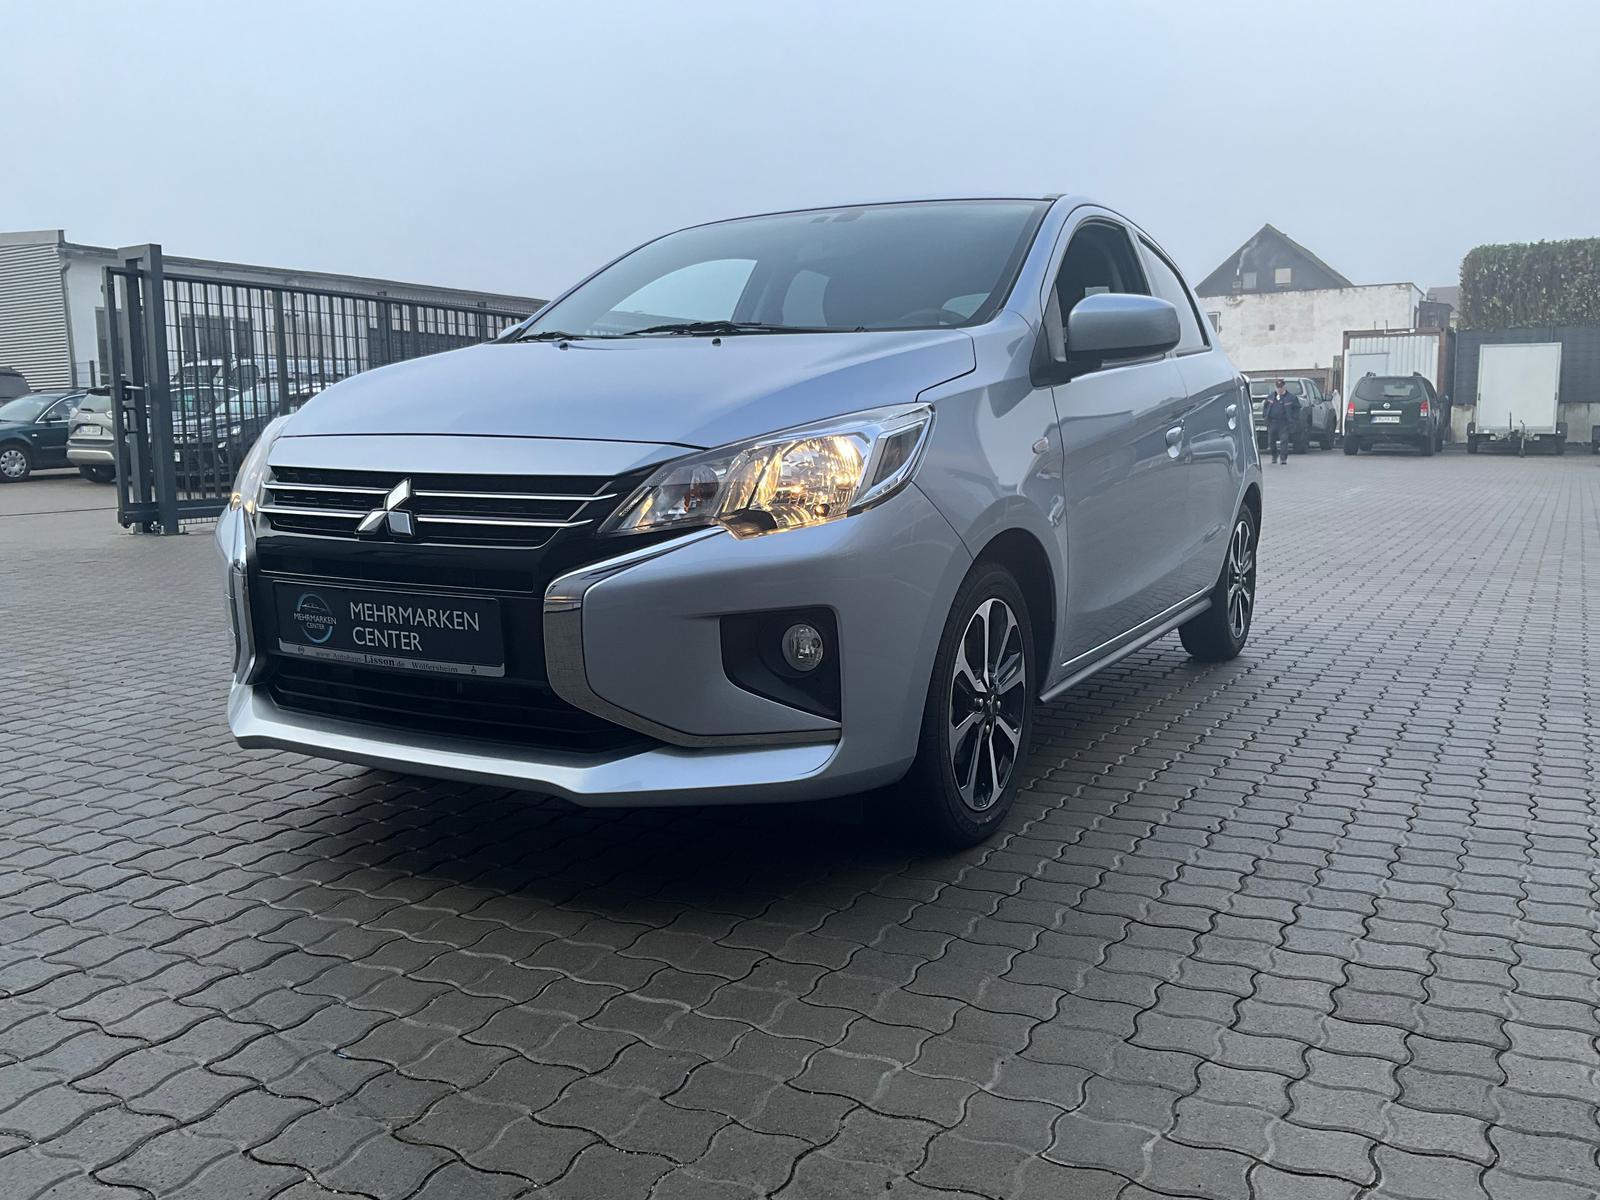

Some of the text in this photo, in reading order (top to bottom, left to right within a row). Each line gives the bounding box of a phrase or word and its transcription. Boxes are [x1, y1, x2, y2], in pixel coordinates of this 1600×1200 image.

[293, 612, 337, 625] MEHRMARKEN
[306, 622, 325, 630] CENTER
[350, 602, 480, 631] MEHRMARKEN
[352, 626, 423, 651] CENTER
